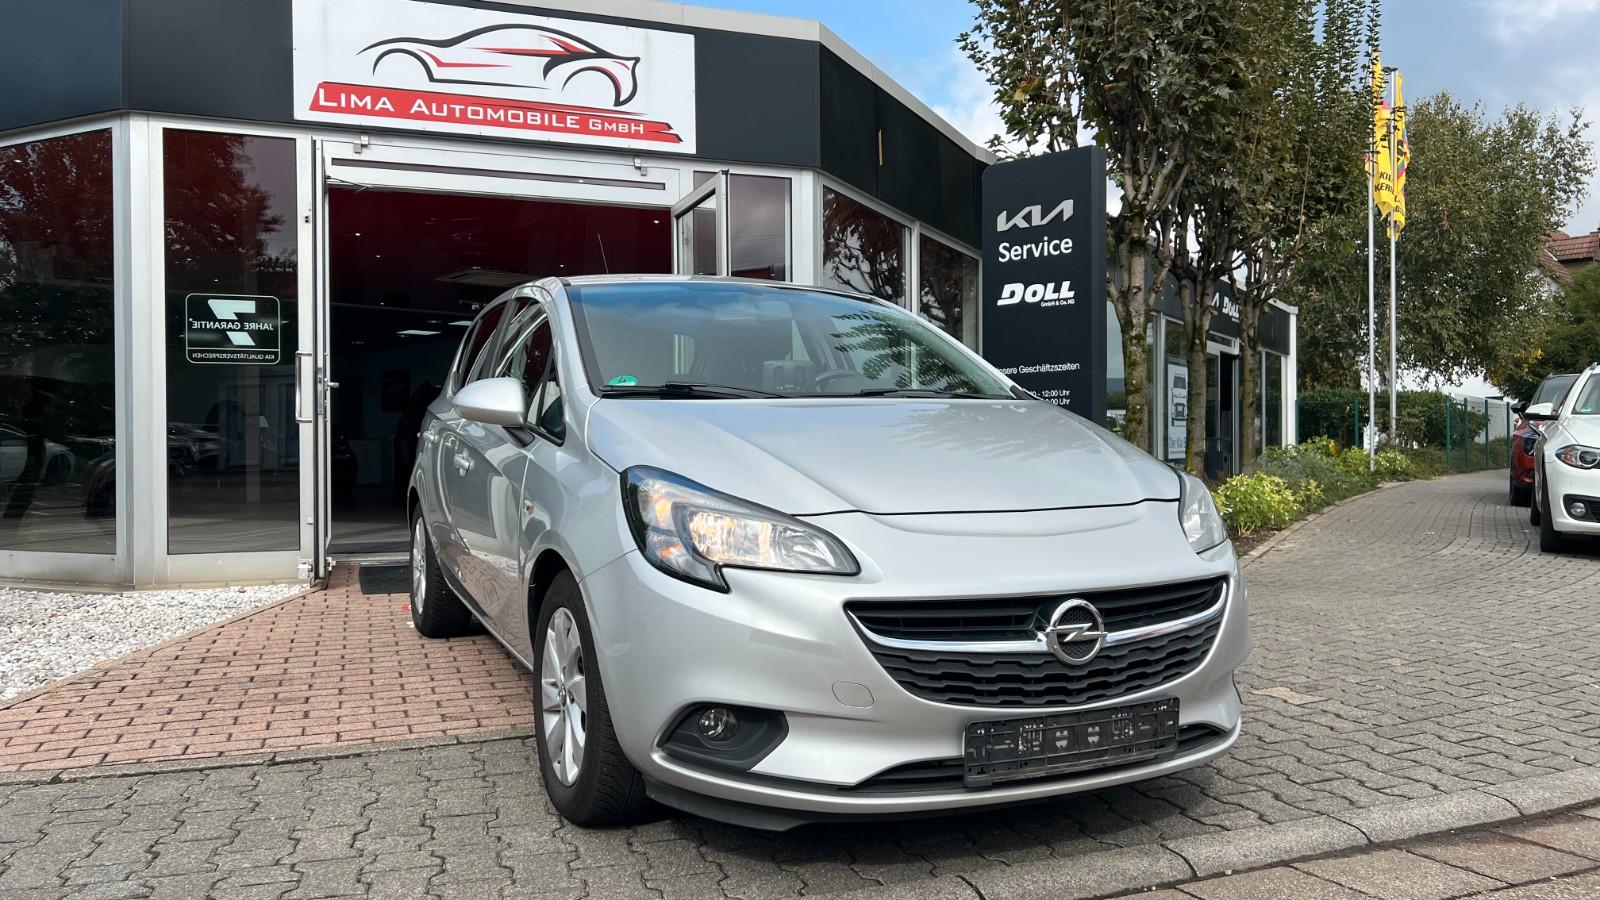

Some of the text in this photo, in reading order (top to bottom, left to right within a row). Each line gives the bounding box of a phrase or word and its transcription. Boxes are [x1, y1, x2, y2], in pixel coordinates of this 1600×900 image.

[318, 87, 395, 113] LIMA
[410, 99, 580, 129] AUTOMOBILE
[998, 236, 1073, 262] Service
[997, 281, 1075, 306] DOLL
[999, 367, 1018, 375] nsere
[1041, 389, 1059, 397] 12:00
